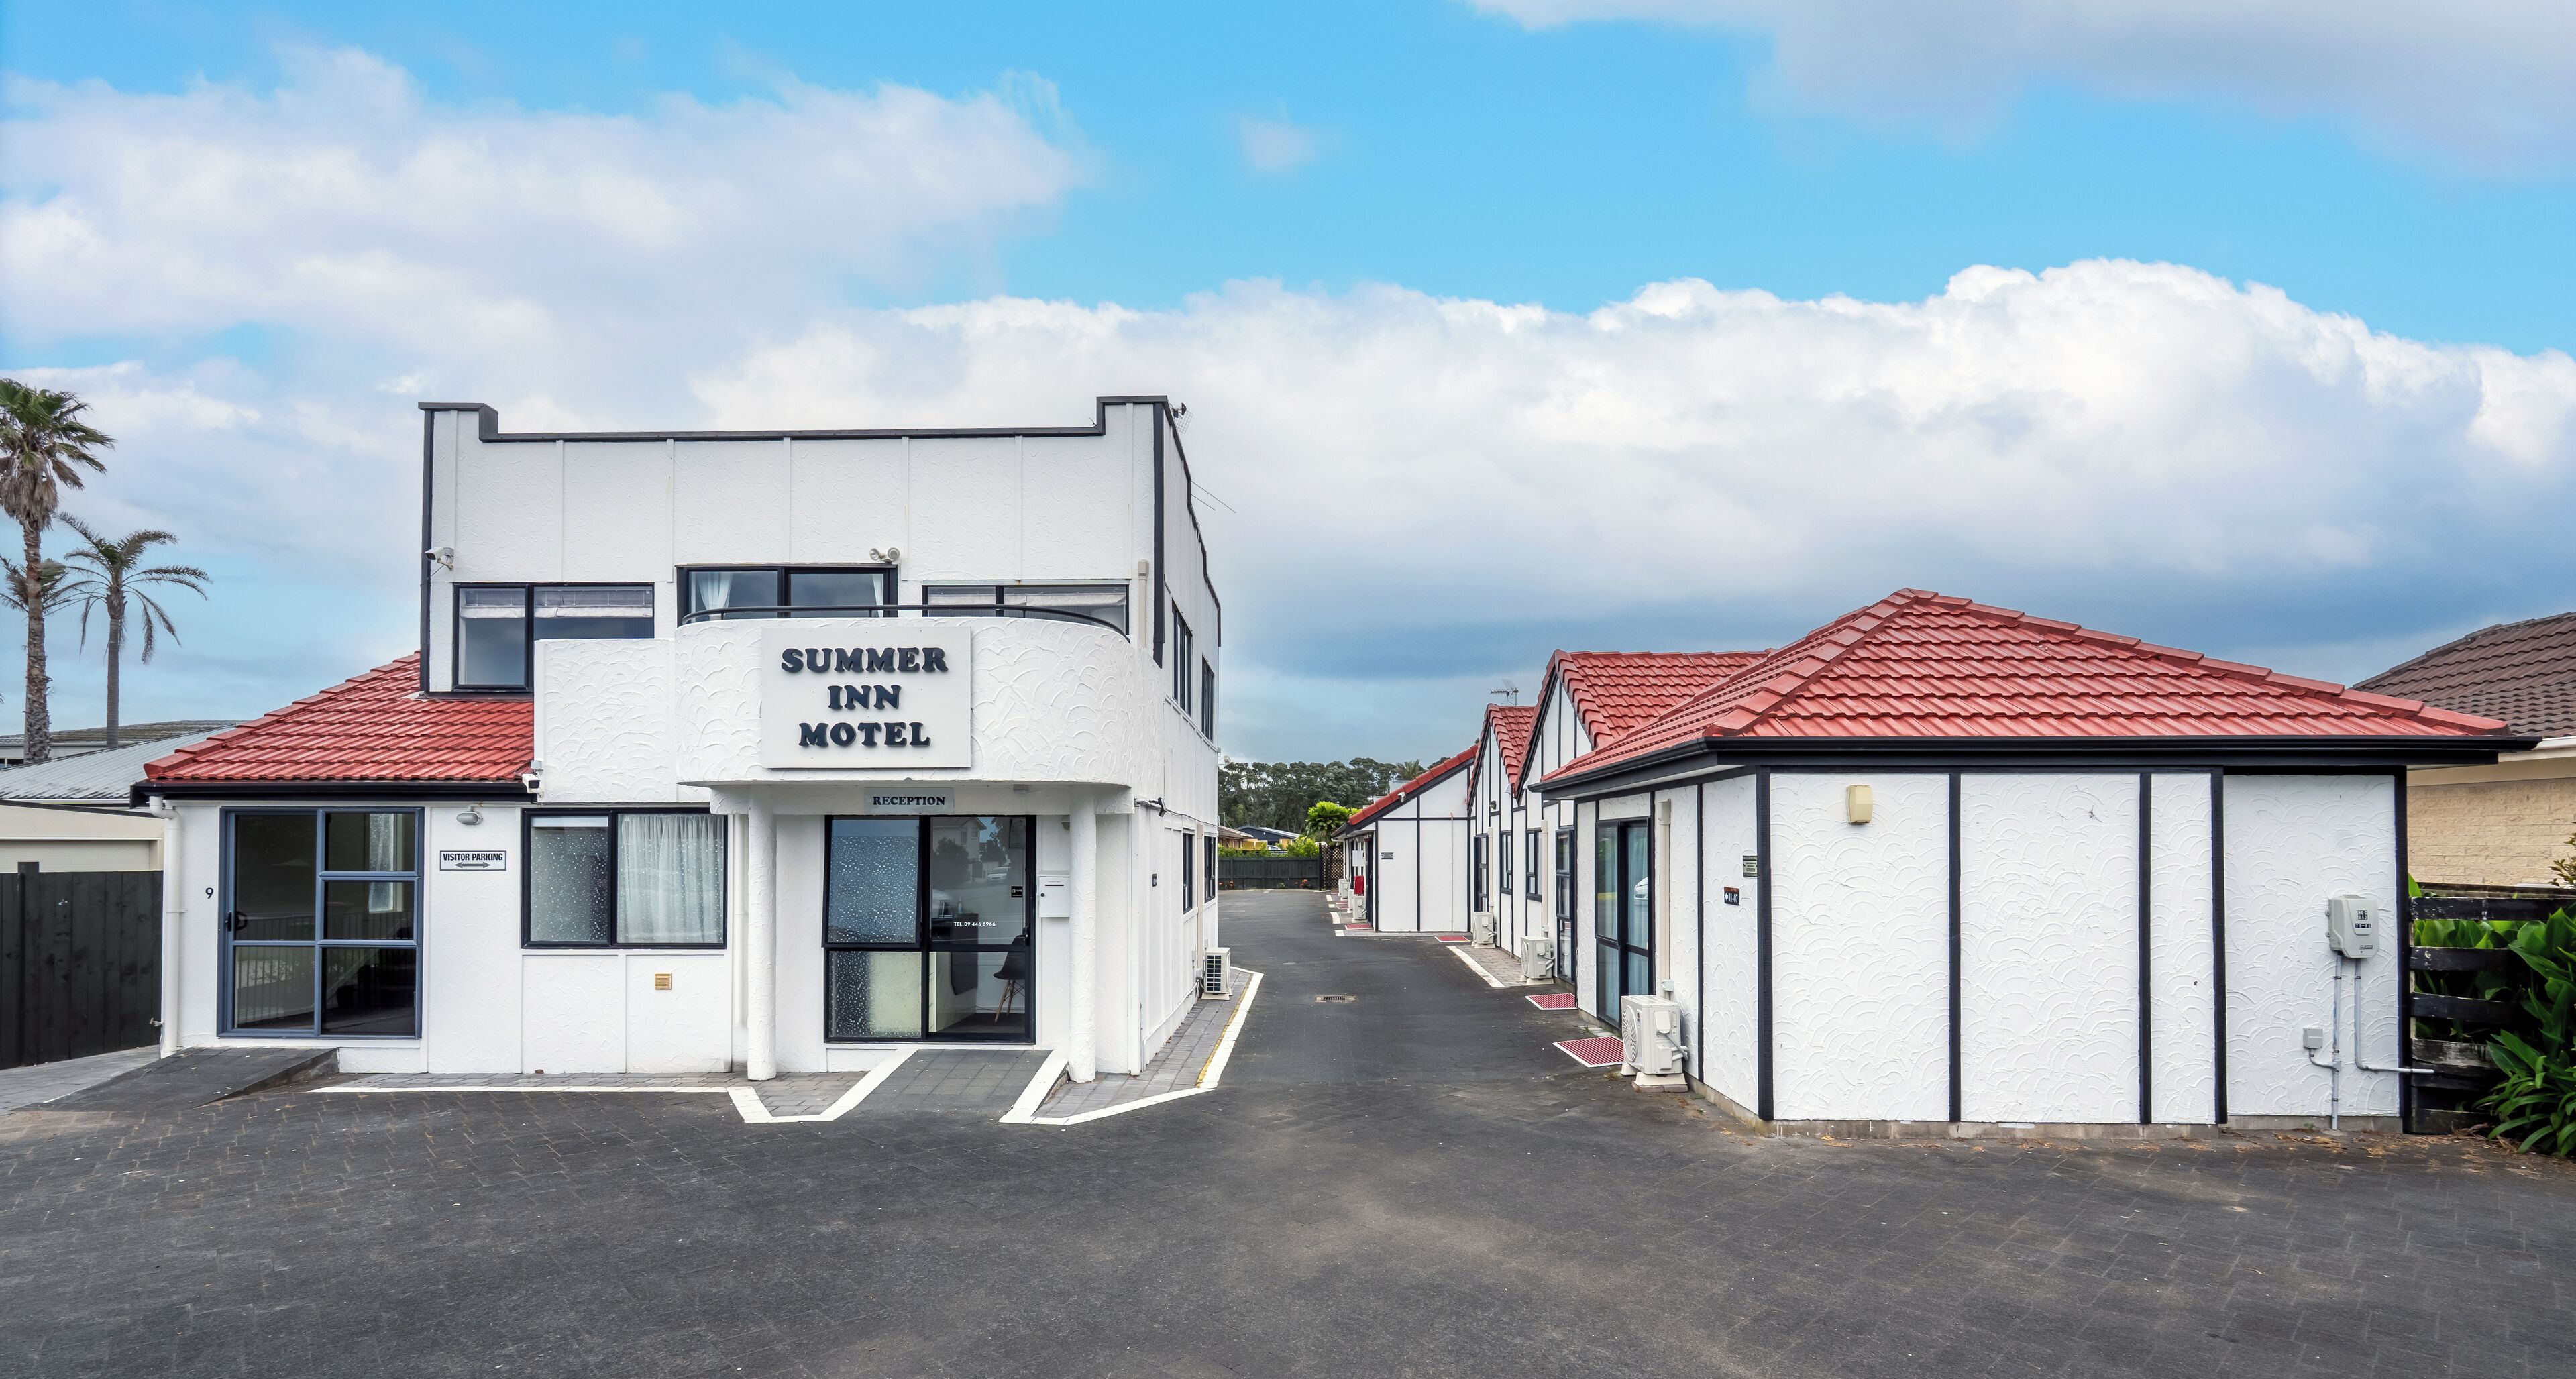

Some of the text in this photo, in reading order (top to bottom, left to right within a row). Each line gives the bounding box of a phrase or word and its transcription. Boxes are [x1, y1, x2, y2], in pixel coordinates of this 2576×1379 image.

[781, 647, 949, 673] SUMMER
[827, 685, 902, 710] INN
[798, 722, 931, 747] MOTEL
[873, 796, 945, 806] RECEPTION
[205, 887, 214, 899] 9
